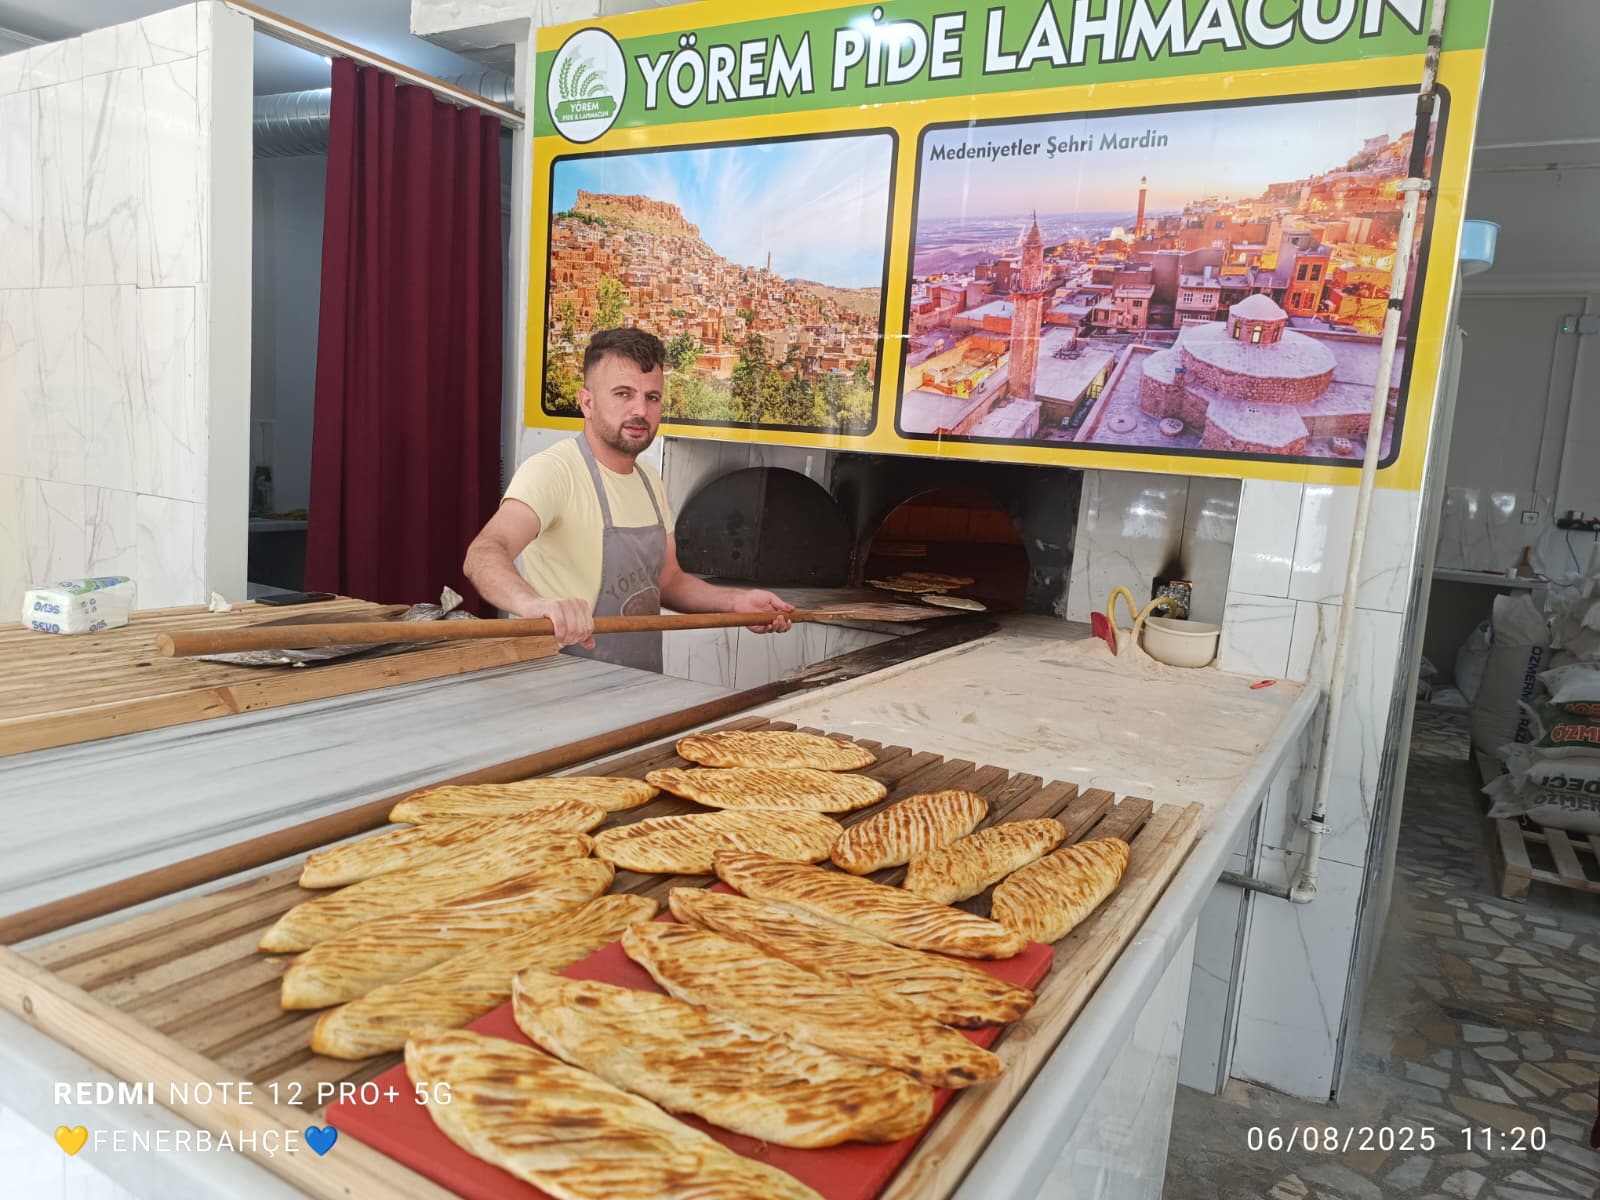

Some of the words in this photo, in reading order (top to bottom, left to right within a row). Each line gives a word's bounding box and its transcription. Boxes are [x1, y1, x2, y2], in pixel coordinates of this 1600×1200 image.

[635, 32, 814, 110] YÖREM
[831, 6, 967, 90] PİDE
[983, 0, 1424, 75] LAHMACUN
[930, 139, 1041, 162] Medeniyetler
[1046, 134, 1093, 159] Şehri
[1099, 128, 1169, 151] Mardin
